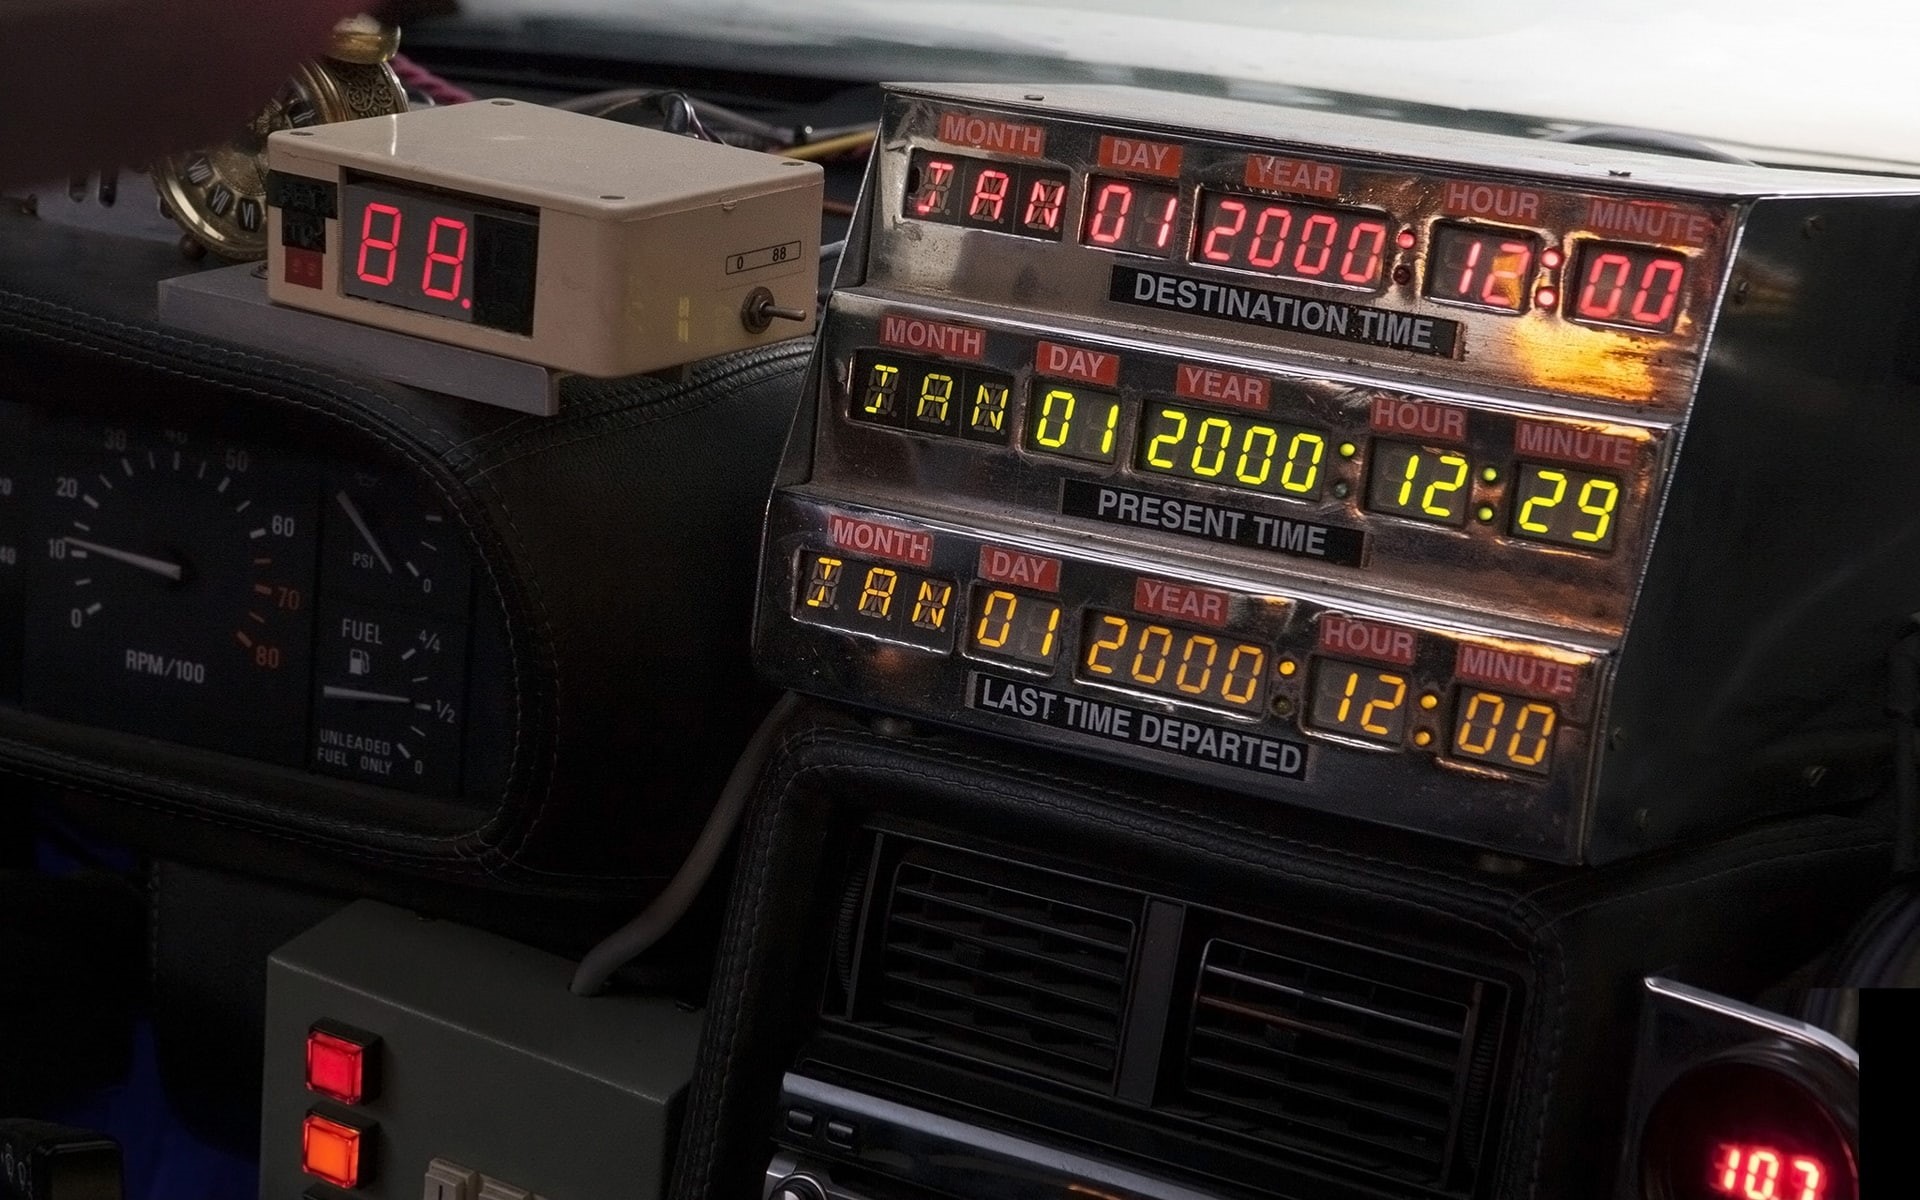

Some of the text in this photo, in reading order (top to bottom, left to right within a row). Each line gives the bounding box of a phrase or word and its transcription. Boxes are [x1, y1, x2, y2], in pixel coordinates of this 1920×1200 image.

[943, 115, 1042, 153] MONTH
[1110, 139, 1170, 171] DAY
[1254, 155, 1335, 193] YEAR
[241, 201, 255, 230] VI
[1447, 184, 1541, 220] HOUR
[1091, 183, 1178, 248] 01
[1203, 200, 1387, 284] 2000
[1589, 202, 1707, 243] MINUTE
[772, 246, 787, 262] 88
[1134, 272, 1434, 349] DESTINATION TIME
[883, 317, 982, 355] MONTH
[1049, 345, 1105, 378] DAY
[1185, 367, 1264, 405] YEAR
[1374, 400, 1465, 436] HOUR
[1036, 389, 1119, 454] 01
[1147, 409, 1324, 493] 2000
[1519, 423, 1634, 466] MINUTE
[224, 450, 250, 473] 50
[56, 476, 78, 499] 20
[271, 515, 295, 538] 60
[833, 519, 930, 561] MONTH
[1097, 488, 1328, 556] PRESENT TIME
[48, 538, 66, 560] 10
[352, 551, 375, 570] PSI
[991, 551, 1048, 584] DAY
[276, 586, 301, 611] 70
[1143, 581, 1223, 621] YEAR
[70, 608, 82, 629] 0
[342, 618, 383, 645] FUEL
[418, 629, 441, 653] 4/4
[977, 590, 1061, 657] 01
[1087, 615, 1265, 704] 2000
[1325, 618, 1414, 658] HOUR
[125, 648, 206, 685] RPM/100
[255, 645, 281, 669] 80
[1461, 647, 1574, 694] MINUTE
[436, 699, 456, 724] 1/2
[982, 678, 1302, 775] LAST TIME DEPARTED
[319, 728, 391, 757] UNLEADED
[317, 747, 393, 775] FUEL ONLY
